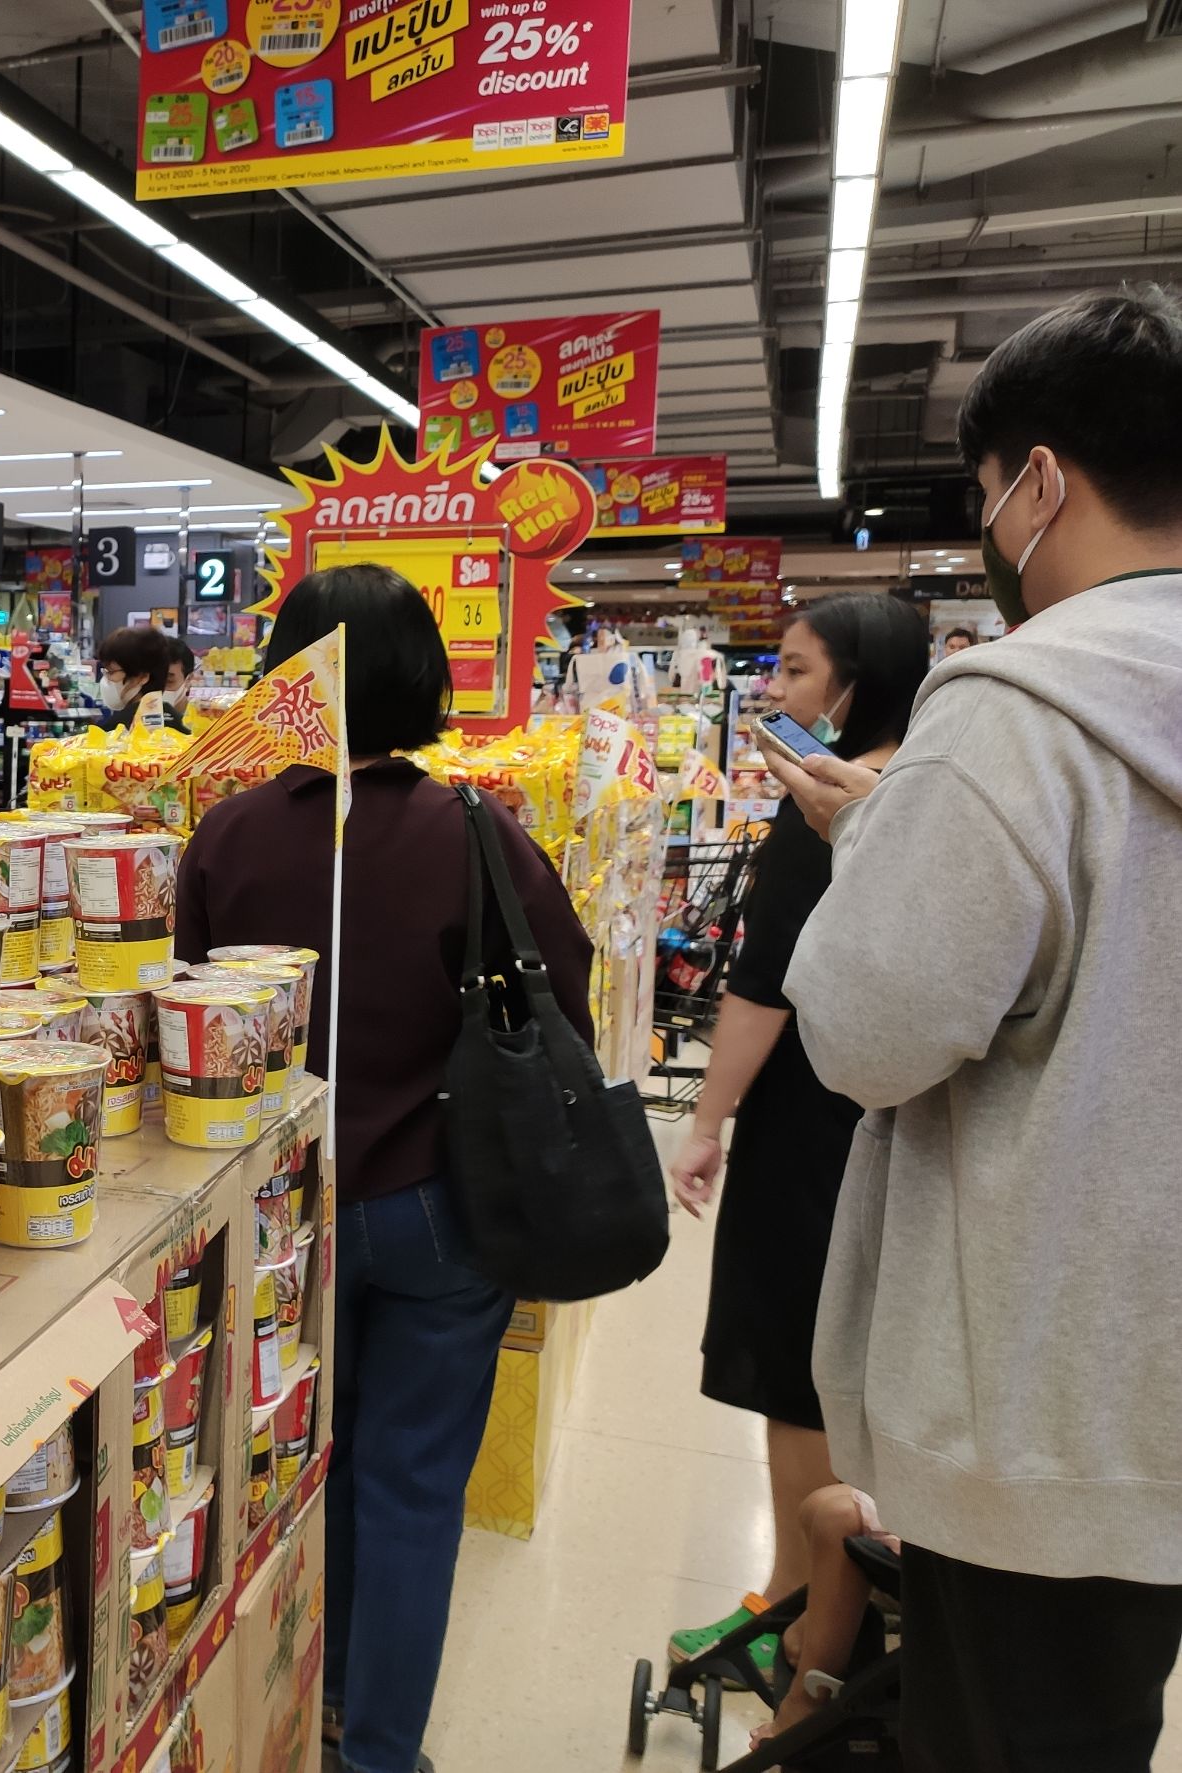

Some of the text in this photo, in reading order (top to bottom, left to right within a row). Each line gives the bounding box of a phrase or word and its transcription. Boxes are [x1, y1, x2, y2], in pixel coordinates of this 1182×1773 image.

[481, 0, 546, 18] with up to
[478, 61, 590, 96] discount
[155, 171, 170, 181] Oct
[173, 169, 194, 179] 2020
[209, 166, 227, 175] Nov
[229, 164, 250, 174] 2020
[315, 480, 476, 537] ลดสุดขีด
[499, 481, 557, 522] Red
[514, 502, 569, 543] Hot
[96, 536, 120, 576] 3
[459, 555, 491, 586] Sale
[200, 558, 226, 596] 2
